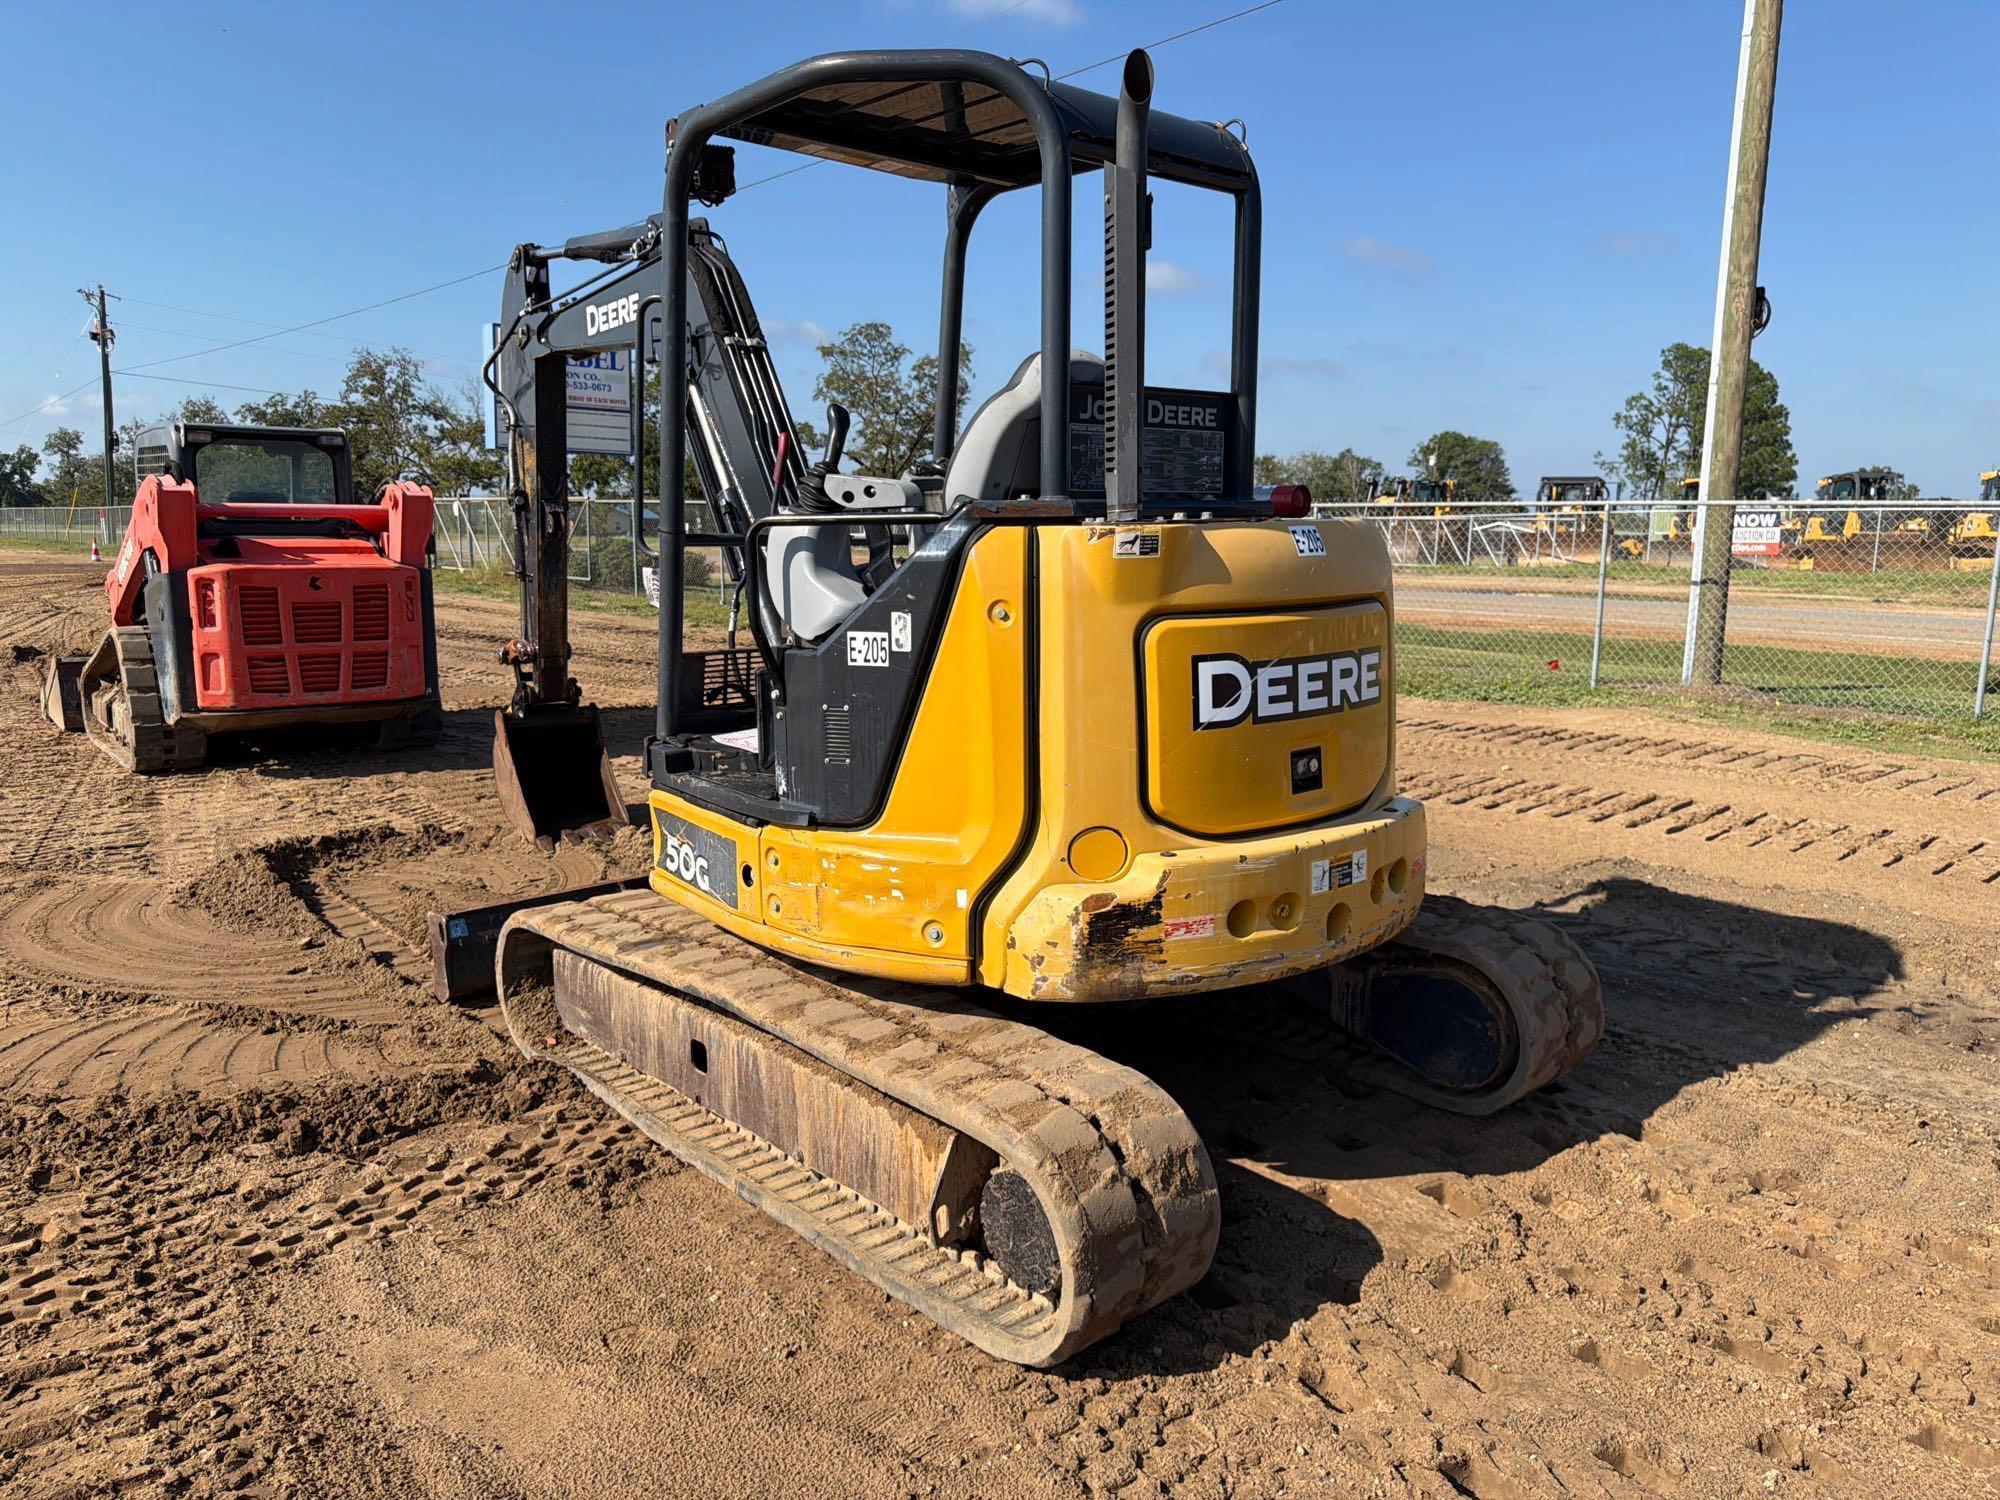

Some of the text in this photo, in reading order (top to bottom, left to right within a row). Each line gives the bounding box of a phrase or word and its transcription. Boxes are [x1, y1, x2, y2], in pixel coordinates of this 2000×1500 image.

[586, 293, 639, 336] DEERE
[566, 371, 600, 381] ON CO.
[1079, 394, 1217, 427] JO DEERE
[1733, 513, 1777, 528] NOW
[1291, 529, 1325, 553] E-205
[1734, 530, 1764, 541] AUCTION
[849, 637, 888, 663] E-205
[1197, 651, 1380, 724] DEERE
[665, 836, 710, 891] 50G
